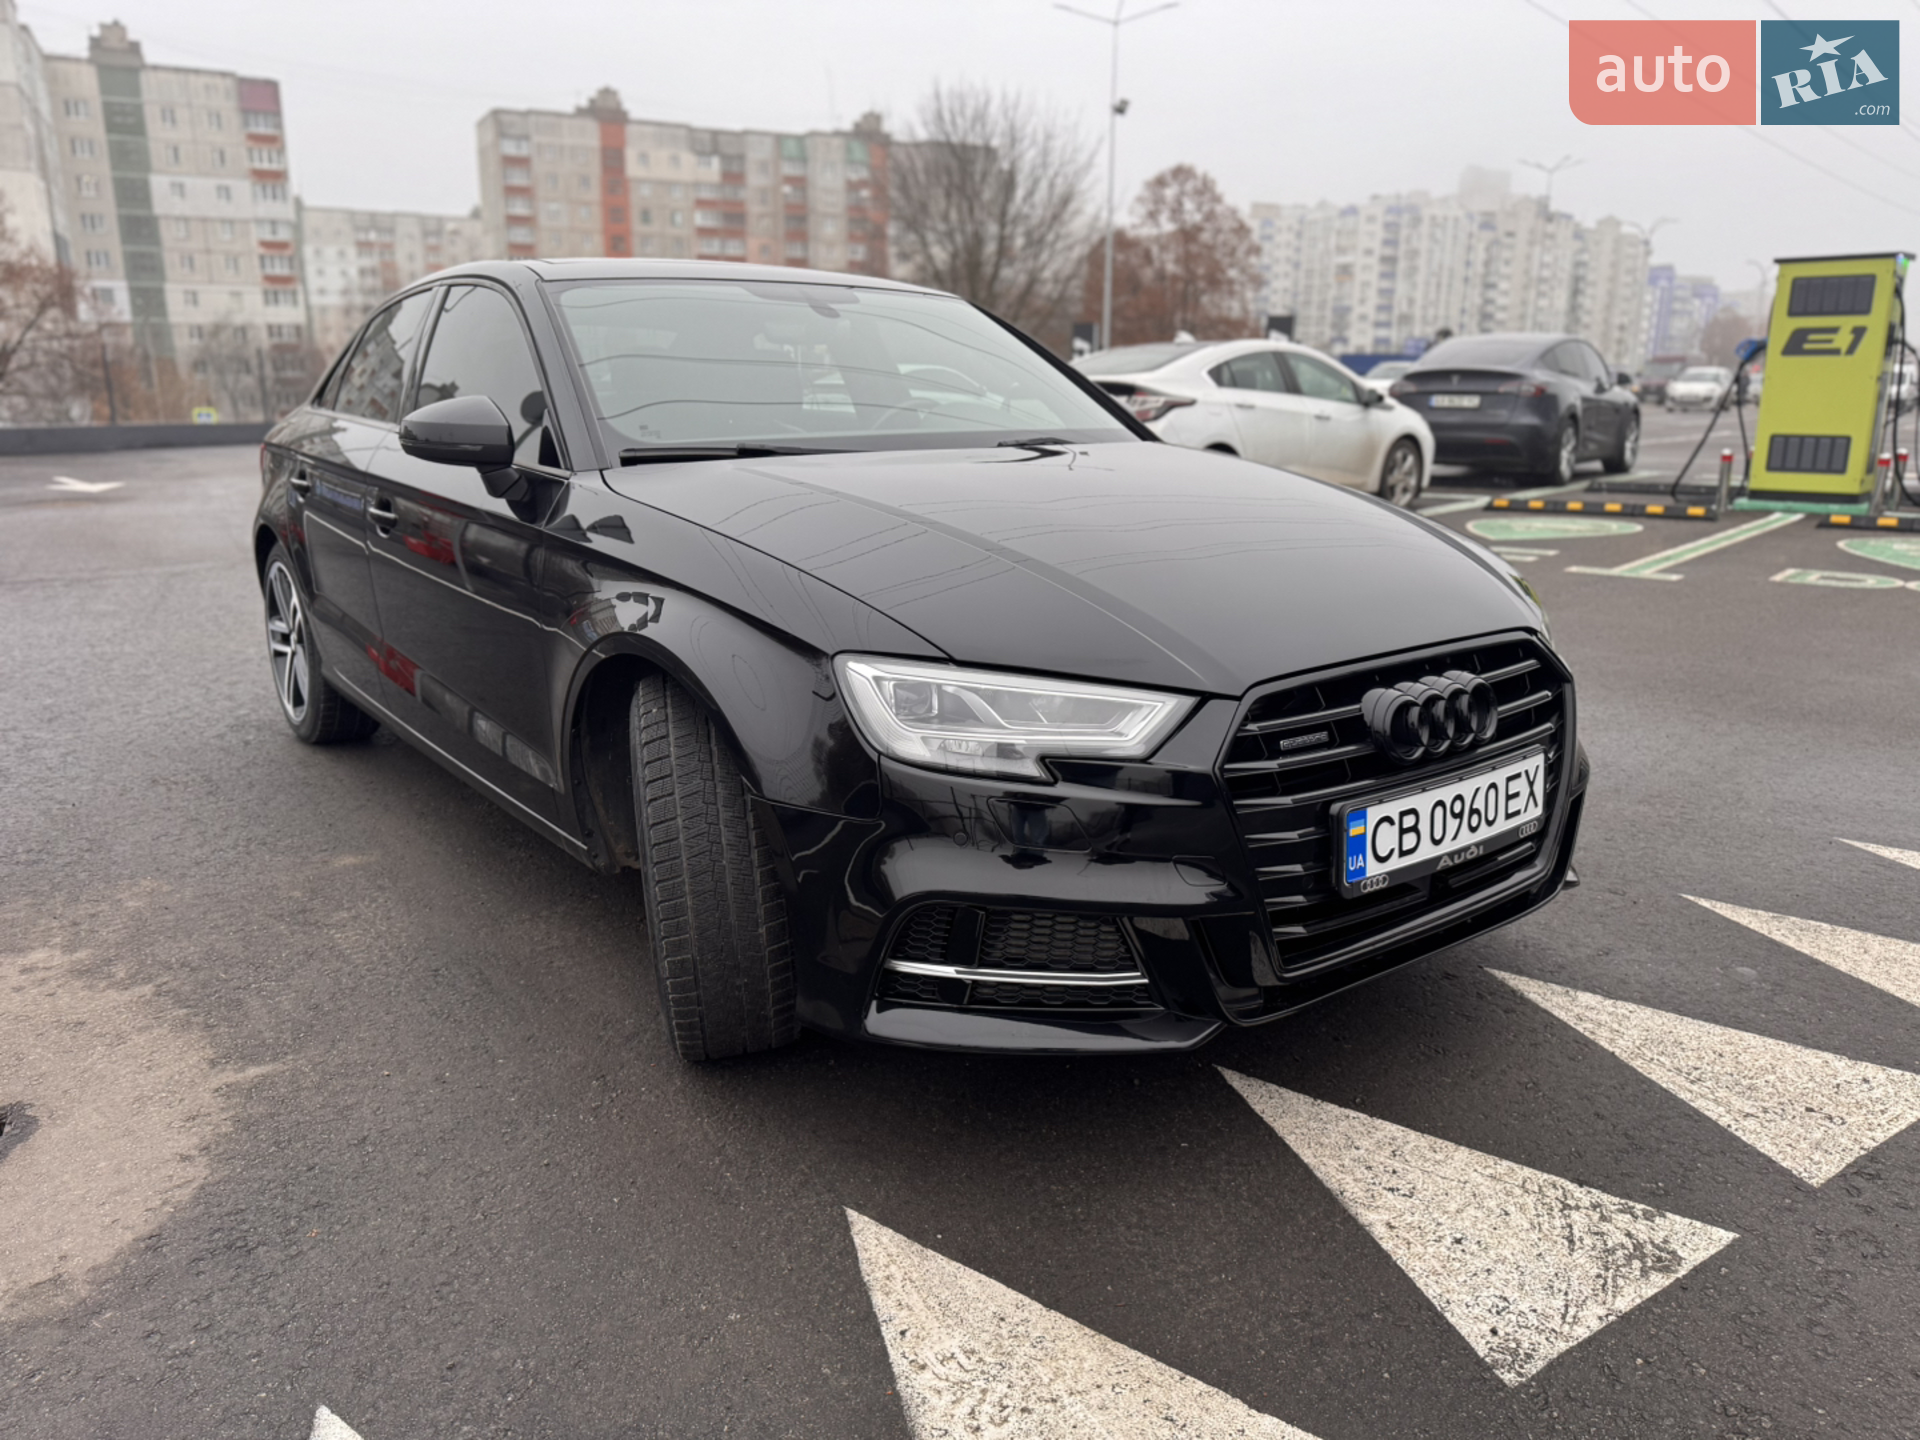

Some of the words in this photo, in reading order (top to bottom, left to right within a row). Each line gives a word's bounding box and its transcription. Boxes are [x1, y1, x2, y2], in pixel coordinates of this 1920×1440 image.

[1781, 326, 1868, 356] E1
[1349, 853, 1365, 871] UA
[1436, 845, 1484, 870] Audi
